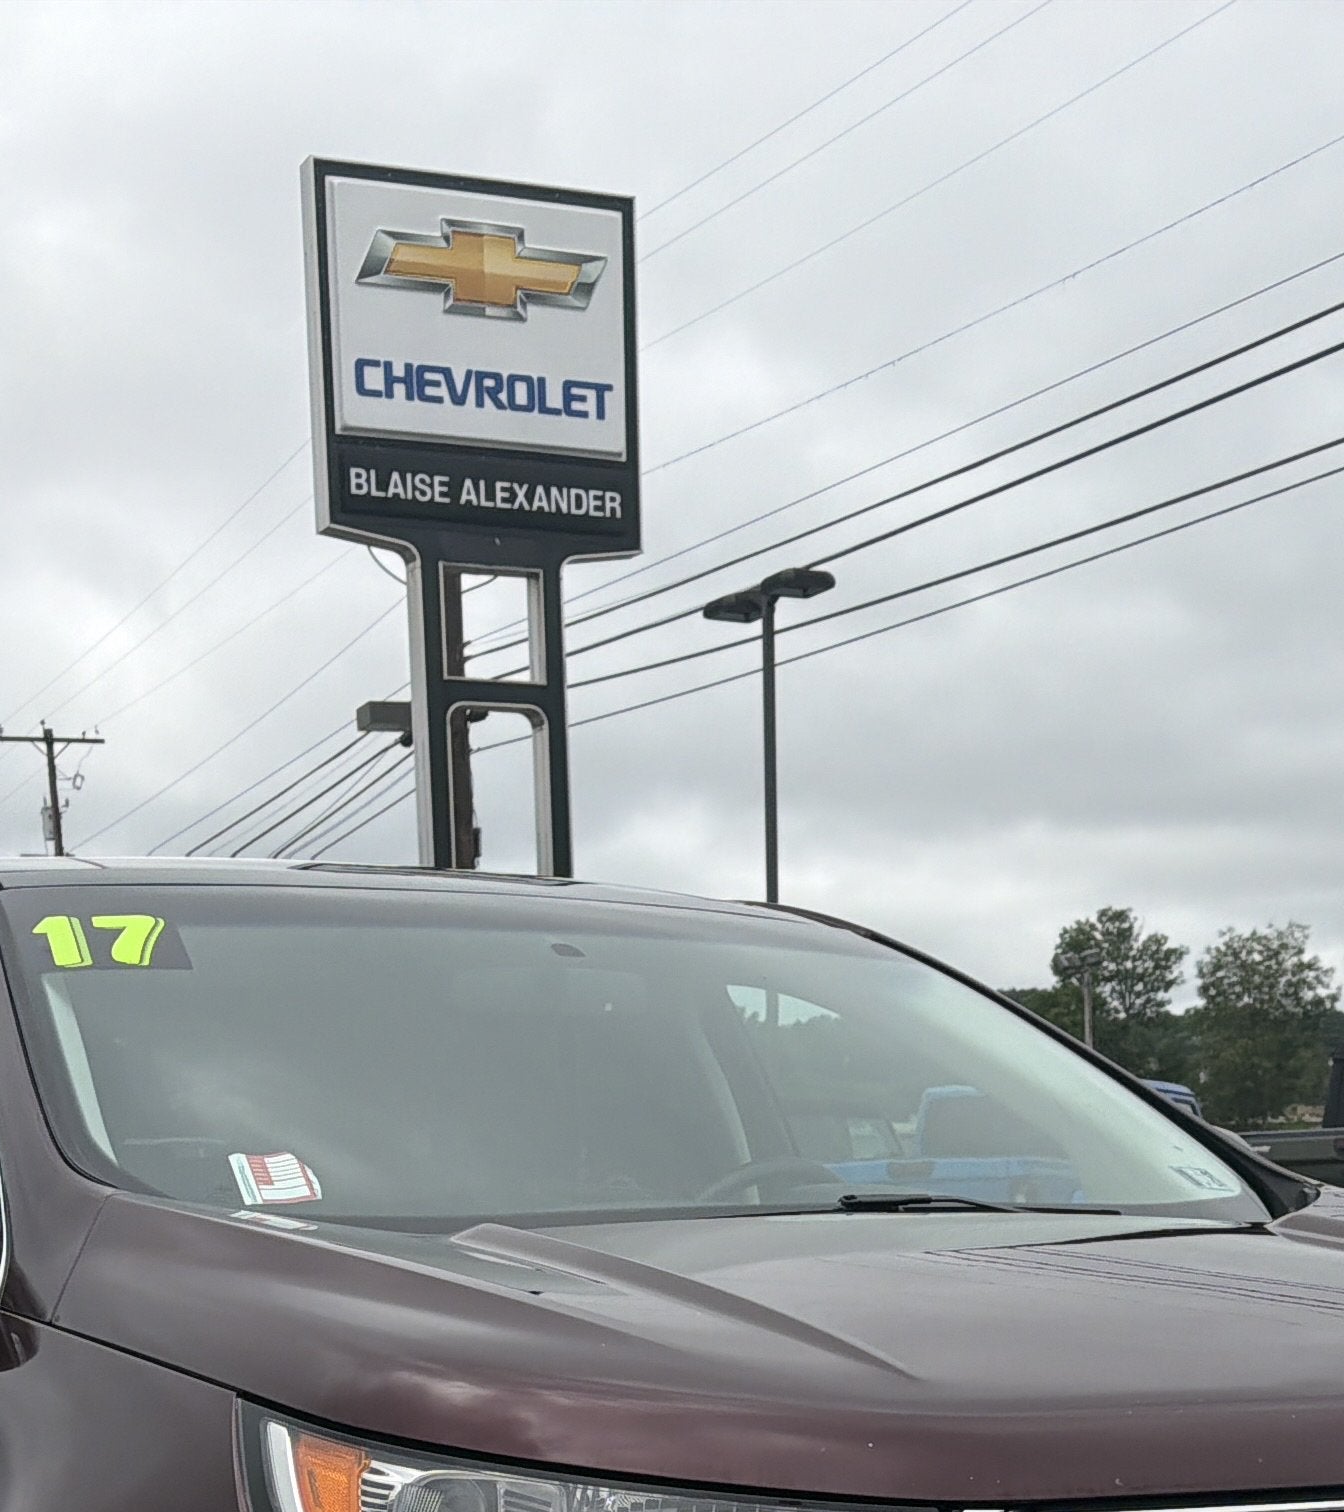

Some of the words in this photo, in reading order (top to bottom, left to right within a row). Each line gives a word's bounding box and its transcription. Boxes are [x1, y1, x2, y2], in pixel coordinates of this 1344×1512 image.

[355, 358, 613, 420] CHEVROLET
[349, 467, 450, 504] BLAISE
[459, 478, 622, 519] ALEXANDER
[32, 915, 165, 967] 17
